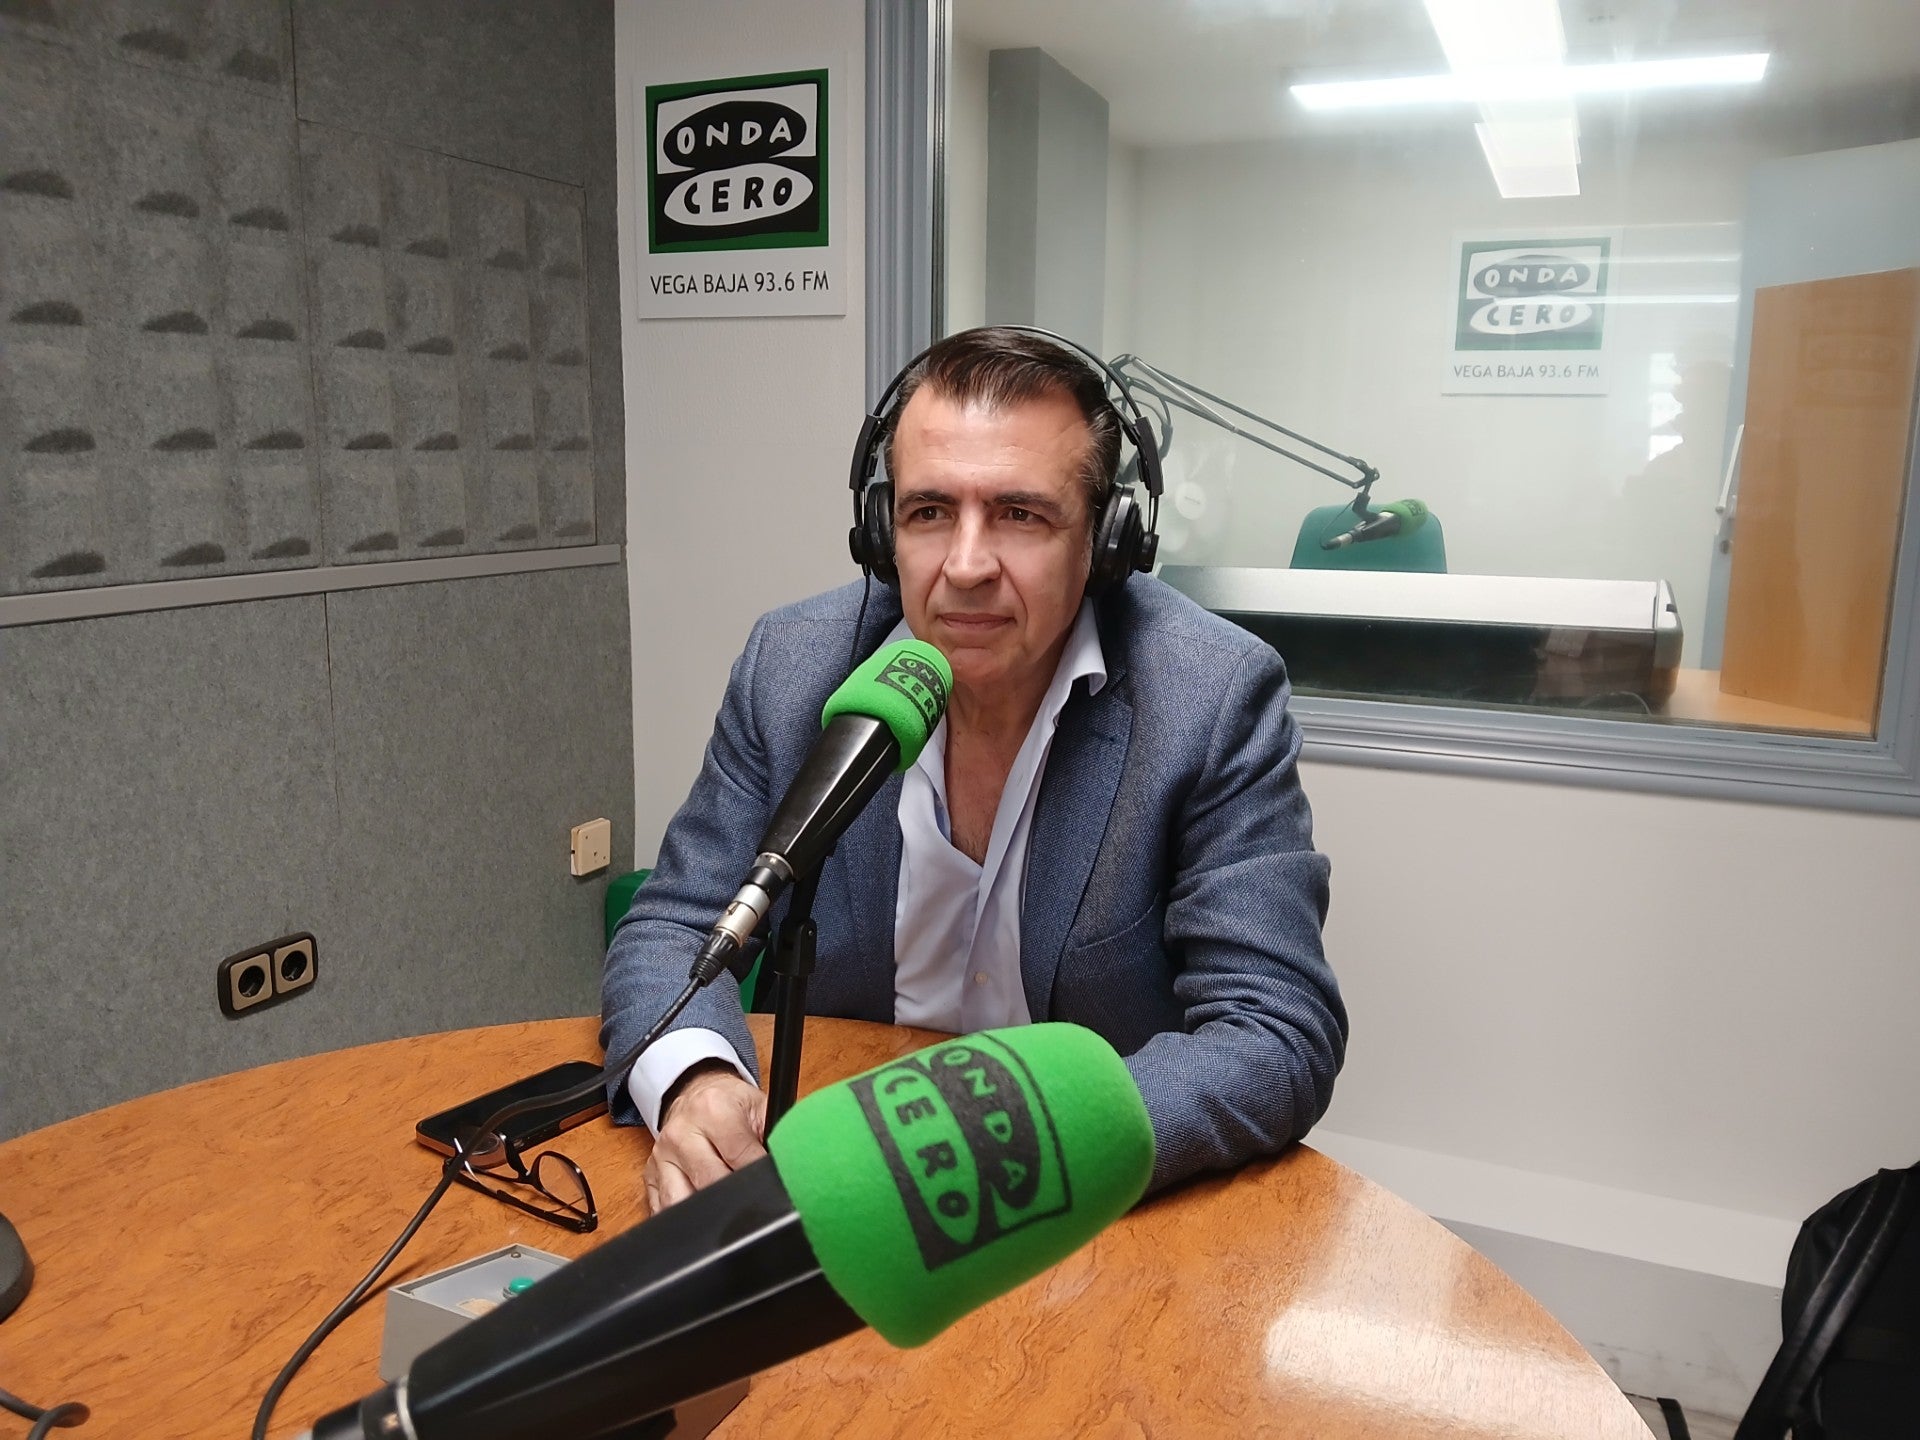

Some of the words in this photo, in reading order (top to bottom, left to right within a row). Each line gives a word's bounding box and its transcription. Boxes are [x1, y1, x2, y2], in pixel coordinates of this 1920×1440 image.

[676, 117, 792, 155] ONDA
[683, 176, 793, 214] CERO
[650, 274, 698, 295] VEGA
[704, 273, 749, 294] BAJA
[754, 271, 795, 292] 93.6
[803, 270, 829, 291] FM
[1484, 266, 1578, 288] ONDA
[1486, 304, 1576, 326] CERO
[1454, 365, 1492, 378] VEGA
[1497, 365, 1534, 378] BAJA
[1539, 365, 1572, 378] 93.6
[1578, 365, 1599, 378] FM
[943, 1048, 1027, 1190] ONDA
[884, 1075, 970, 1218] CERO
